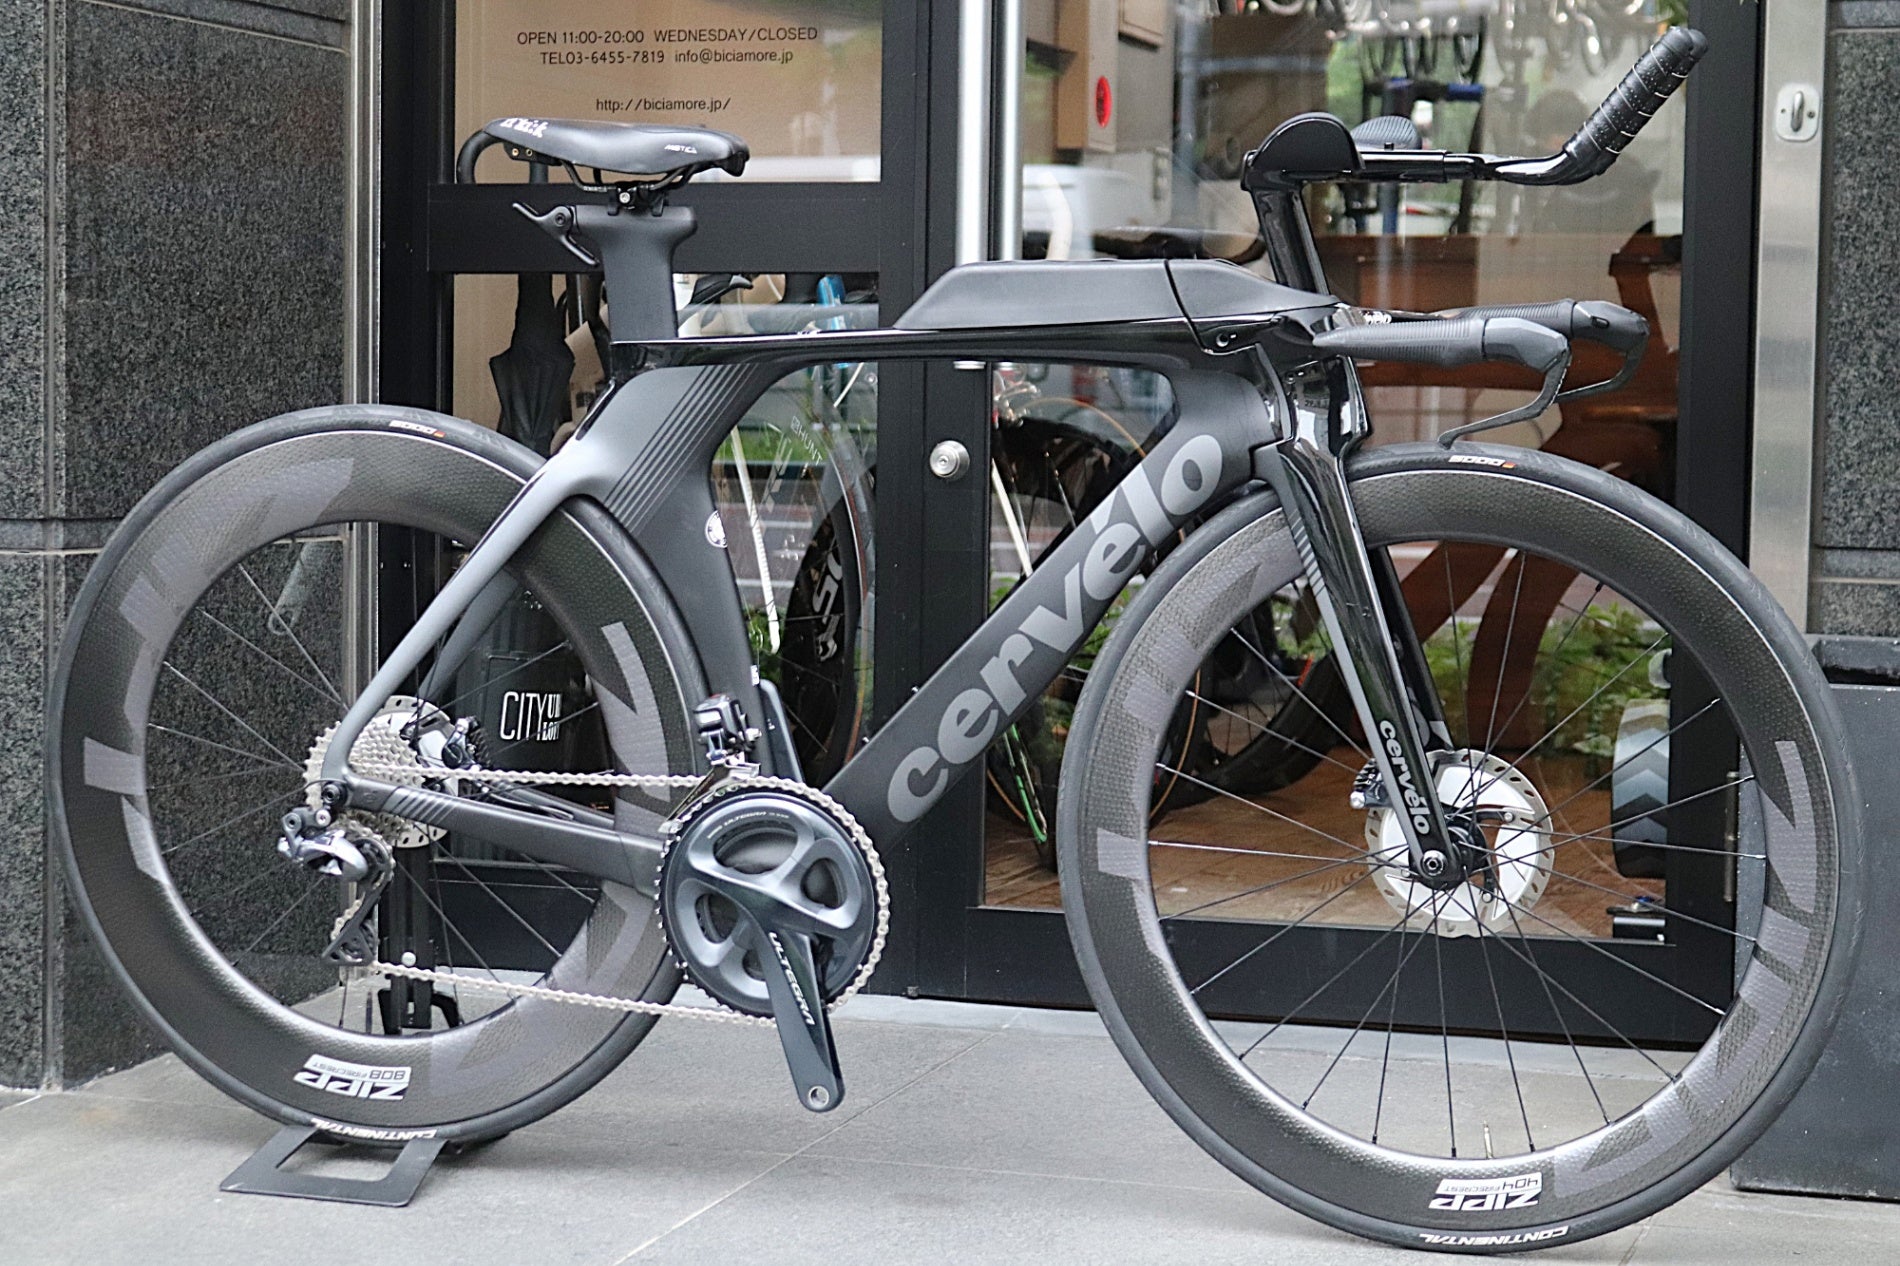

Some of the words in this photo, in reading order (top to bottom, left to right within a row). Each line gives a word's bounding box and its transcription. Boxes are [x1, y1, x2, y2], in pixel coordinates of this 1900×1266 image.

[517, 31, 557, 45] OPEN
[562, 30, 645, 44] 11:00-20:00
[654, 26, 818, 43] WEDNESDAY/CLOSED
[540, 50, 665, 65] TEL03-6455-7819
[674, 48, 794, 64] info@biciamore.jp
[595, 97, 732, 113] http://biciamore.jp/
[797, 424, 823, 467] HUNT
[887, 434, 1223, 822] cervélo
[500, 691, 548, 741] CITY
[1379, 720, 1431, 835] cervélo
[767, 931, 816, 1026] ULTEGRA
[292, 1070, 410, 1101] ZIPP
[369, 1069, 406, 1081] 808
[310, 1116, 438, 1141] CONTINENTAL
[1502, 1178, 1539, 1190] 404
[1428, 1190, 1543, 1212] ZIPP
[1418, 1225, 1570, 1246] CONTINENTAL
